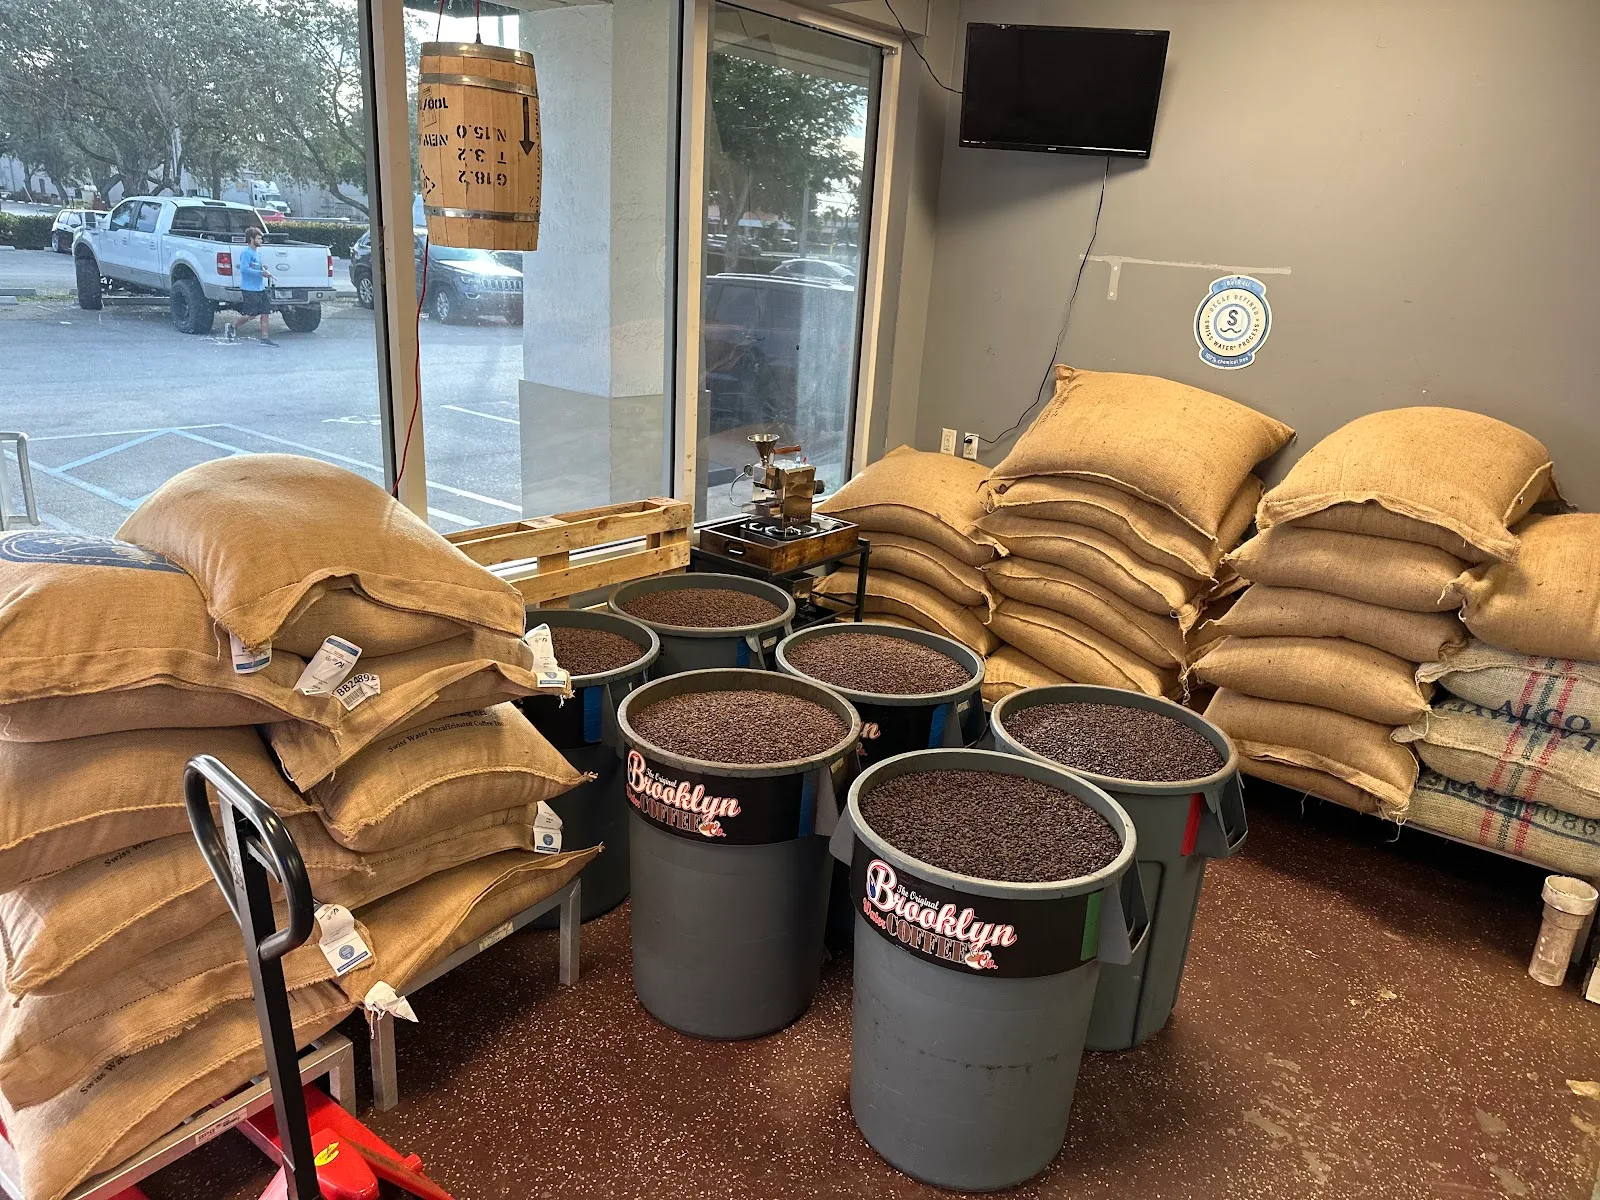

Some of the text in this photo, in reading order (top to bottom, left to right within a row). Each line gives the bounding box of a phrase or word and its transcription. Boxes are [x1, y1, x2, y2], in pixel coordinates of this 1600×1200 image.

[423, 134, 448, 147] NEW
[456, 125, 490, 140] 15.0
[458, 148, 485, 163] 3.2
[1210, 295, 1230, 313] DECAF
[1227, 309, 1239, 327] S
[1204, 320, 1214, 341] SWISS
[1238, 324, 1260, 348] PROCESS
[387, 739, 407, 753] Swiss
[406, 730, 428, 743] Water
[428, 721, 473, 734] Decaffeinated
[627, 749, 741, 822] Brooklyn
[640, 793, 701, 833] COFFEE
[104, 849, 131, 868] Swiss
[866, 859, 1017, 950] Brooklyn
[896, 884, 940, 910] The Original
[886, 912, 968, 964] COFFEE
[80, 1071, 106, 1095] Swiss
